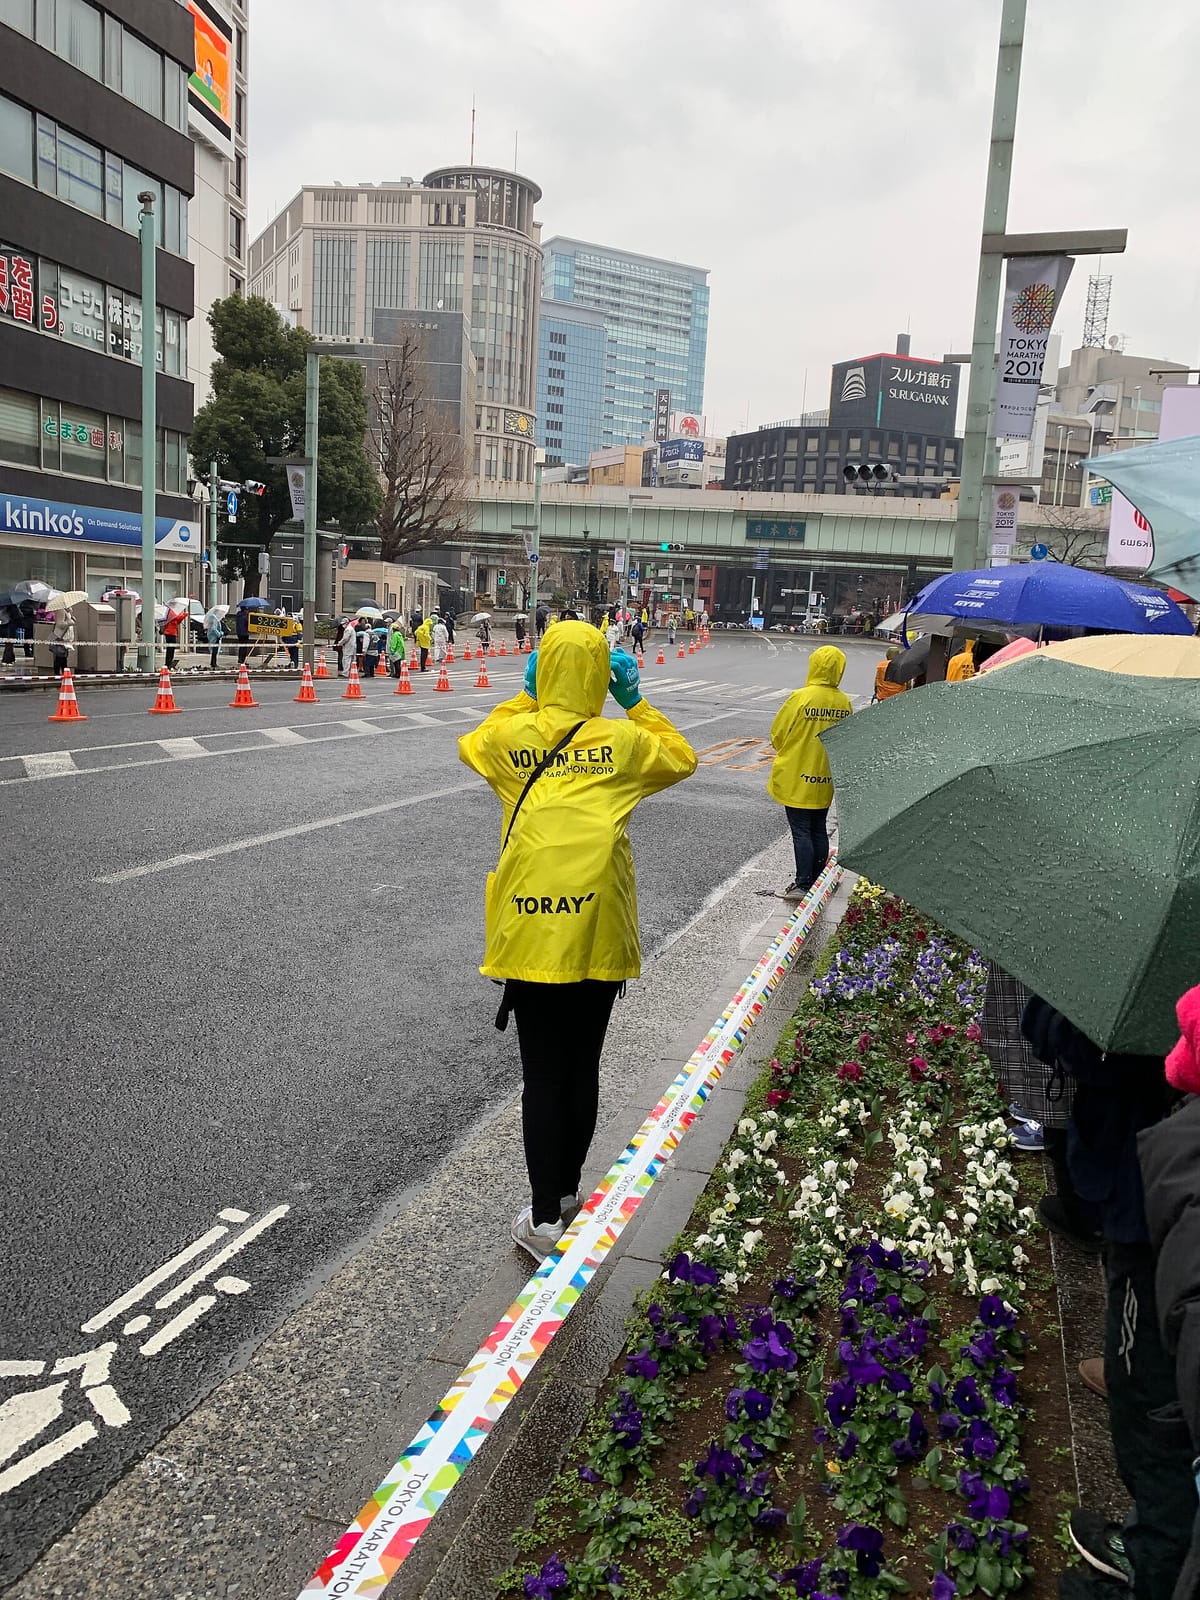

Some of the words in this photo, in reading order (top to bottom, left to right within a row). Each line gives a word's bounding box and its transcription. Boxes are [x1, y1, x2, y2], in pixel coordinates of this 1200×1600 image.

[889, 366, 952, 389] スルガ銀行
[889, 388, 925, 402] SURUGA
[925, 393, 949, 406] BANK
[44, 416, 123, 451] とまる歯科
[6, 501, 84, 535] kinko's
[87, 518, 96, 526] On
[96, 519, 118, 529] Demand
[119, 522, 142, 532] Solutions
[256, 625, 281, 635] SEIKO
[805, 707, 851, 720] VOLUNTEER
[591, 766, 614, 775] 2019
[530, 1289, 557, 1316] TOKYO
[493, 1315, 537, 1367] MARATHON
[388, 1473, 429, 1517] TOKYO
